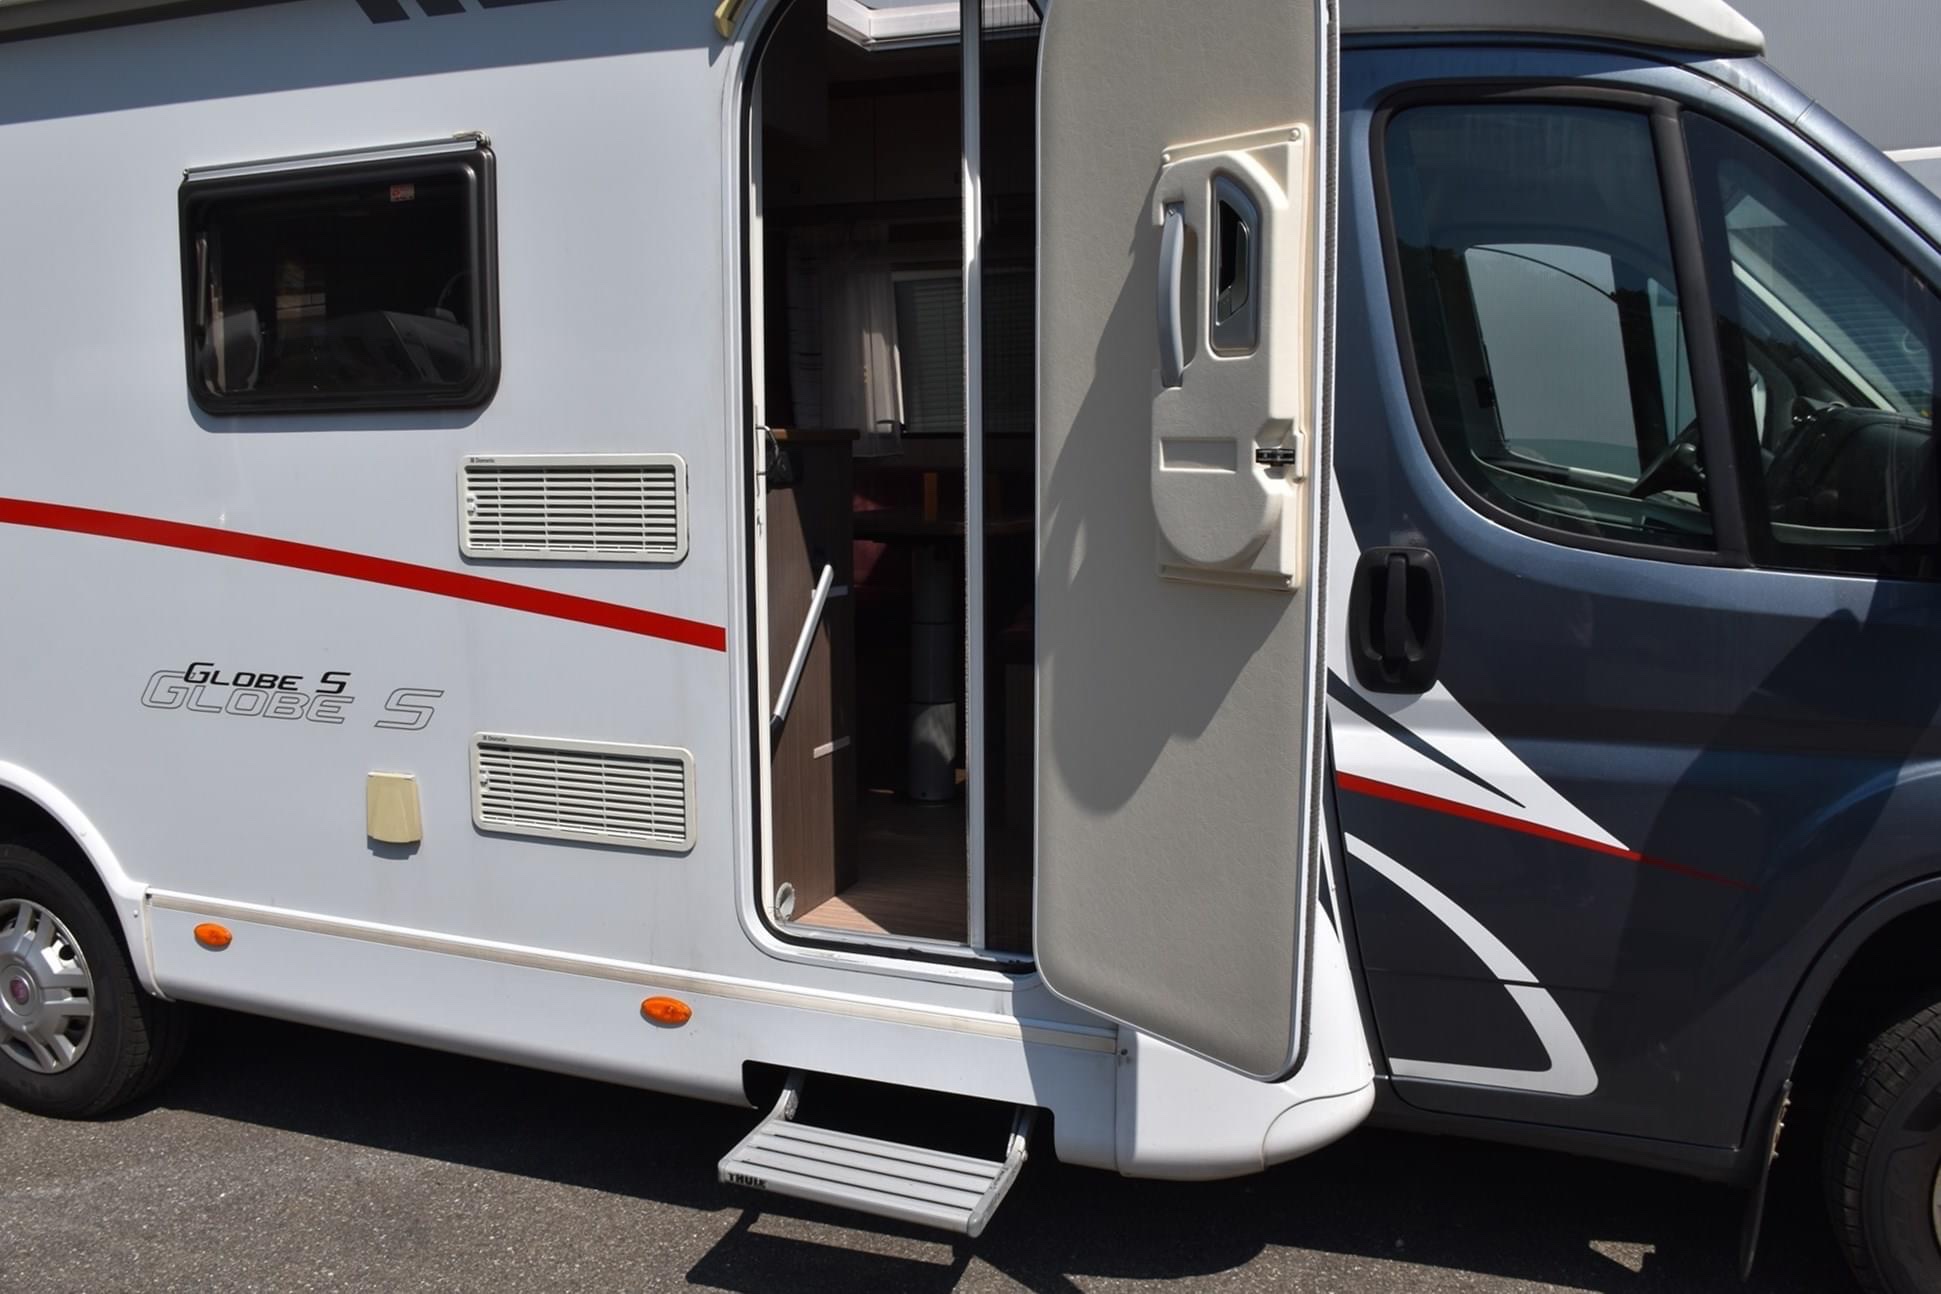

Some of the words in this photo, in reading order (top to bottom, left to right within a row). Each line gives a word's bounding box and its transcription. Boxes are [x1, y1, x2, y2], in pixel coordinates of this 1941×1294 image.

[140, 669, 356, 724] GLOBE
[373, 687, 445, 731] S
[183, 662, 304, 691] GLOBE
[315, 671, 352, 694] S
